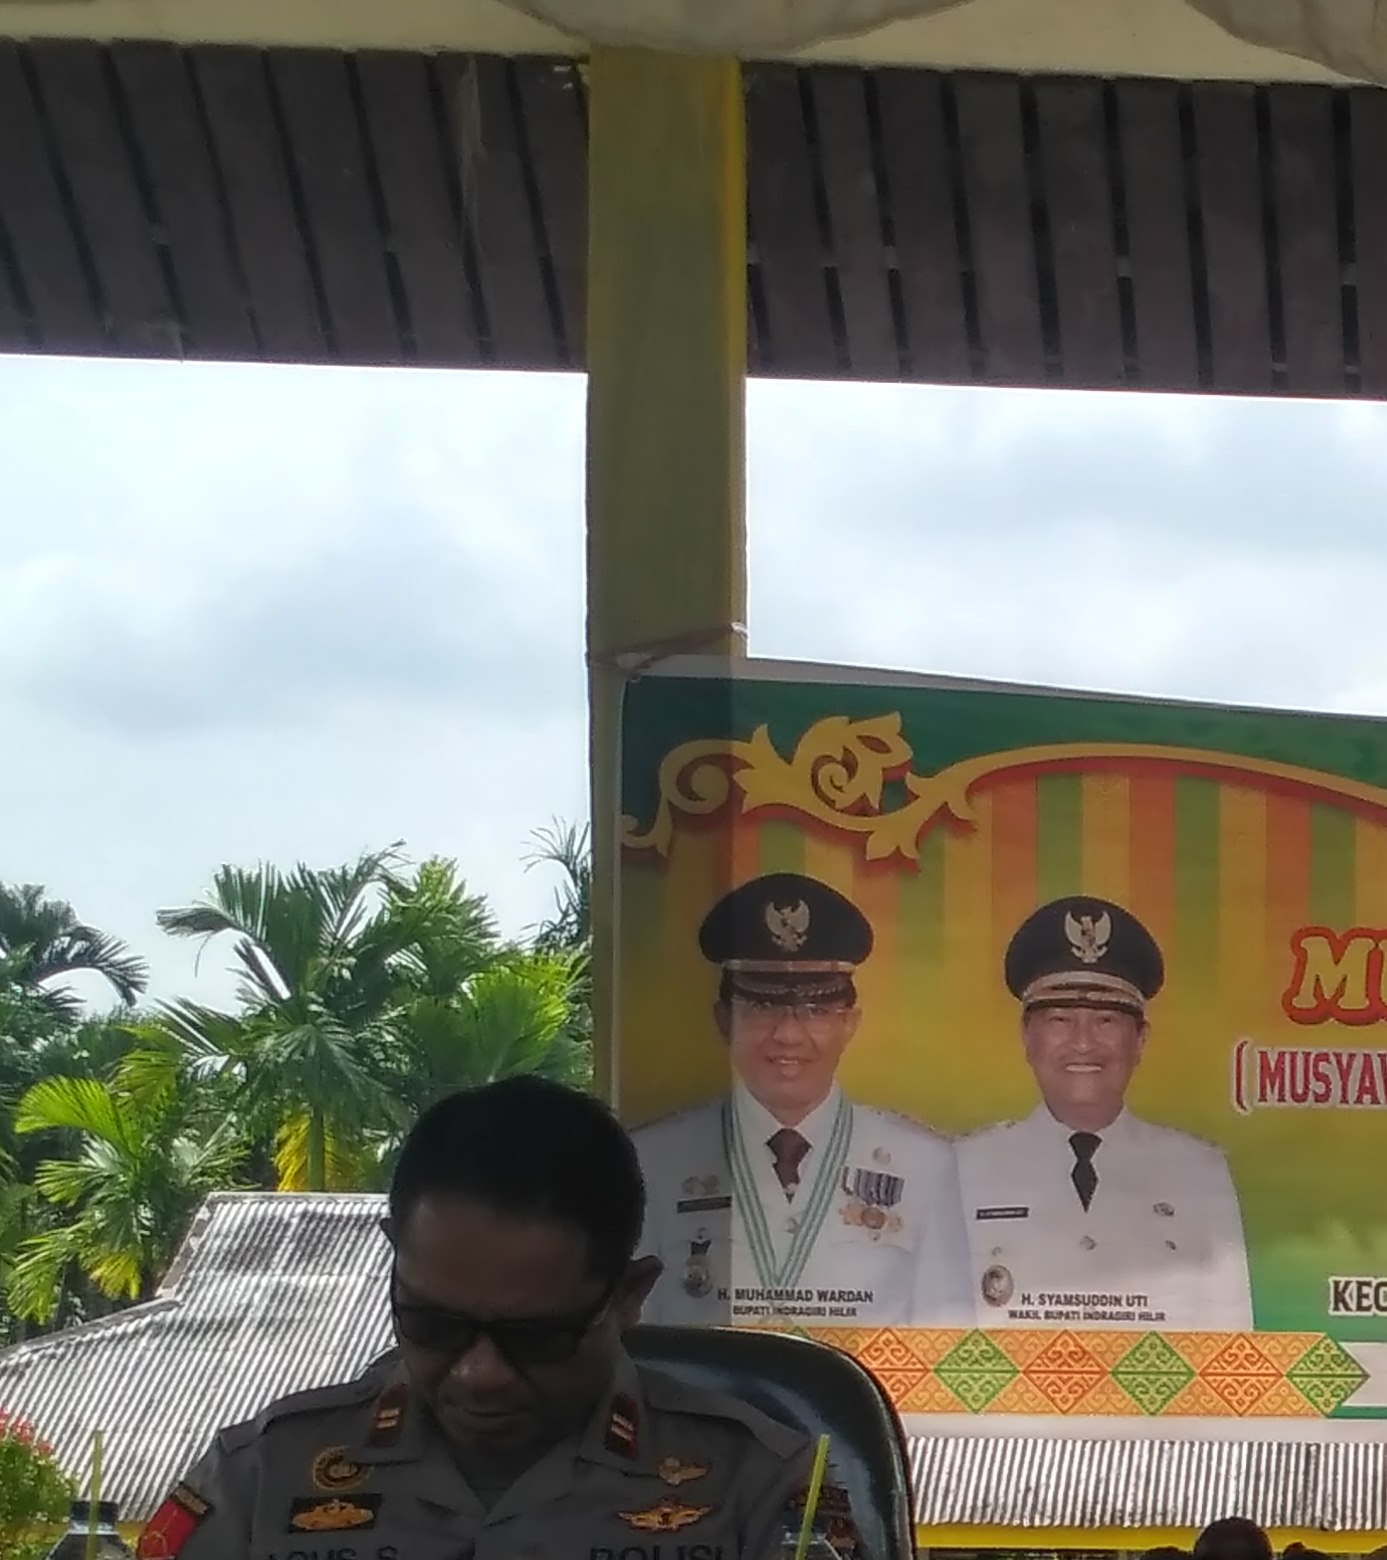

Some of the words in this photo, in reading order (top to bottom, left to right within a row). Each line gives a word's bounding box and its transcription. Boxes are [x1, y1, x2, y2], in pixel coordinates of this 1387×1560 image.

[734, 1288, 814, 1302] MUHAMMAD
[816, 1290, 874, 1304] WARDAN
[1038, 1293, 1123, 1307] SYAMSUDDIN
[1125, 1295, 1149, 1308] UTI
